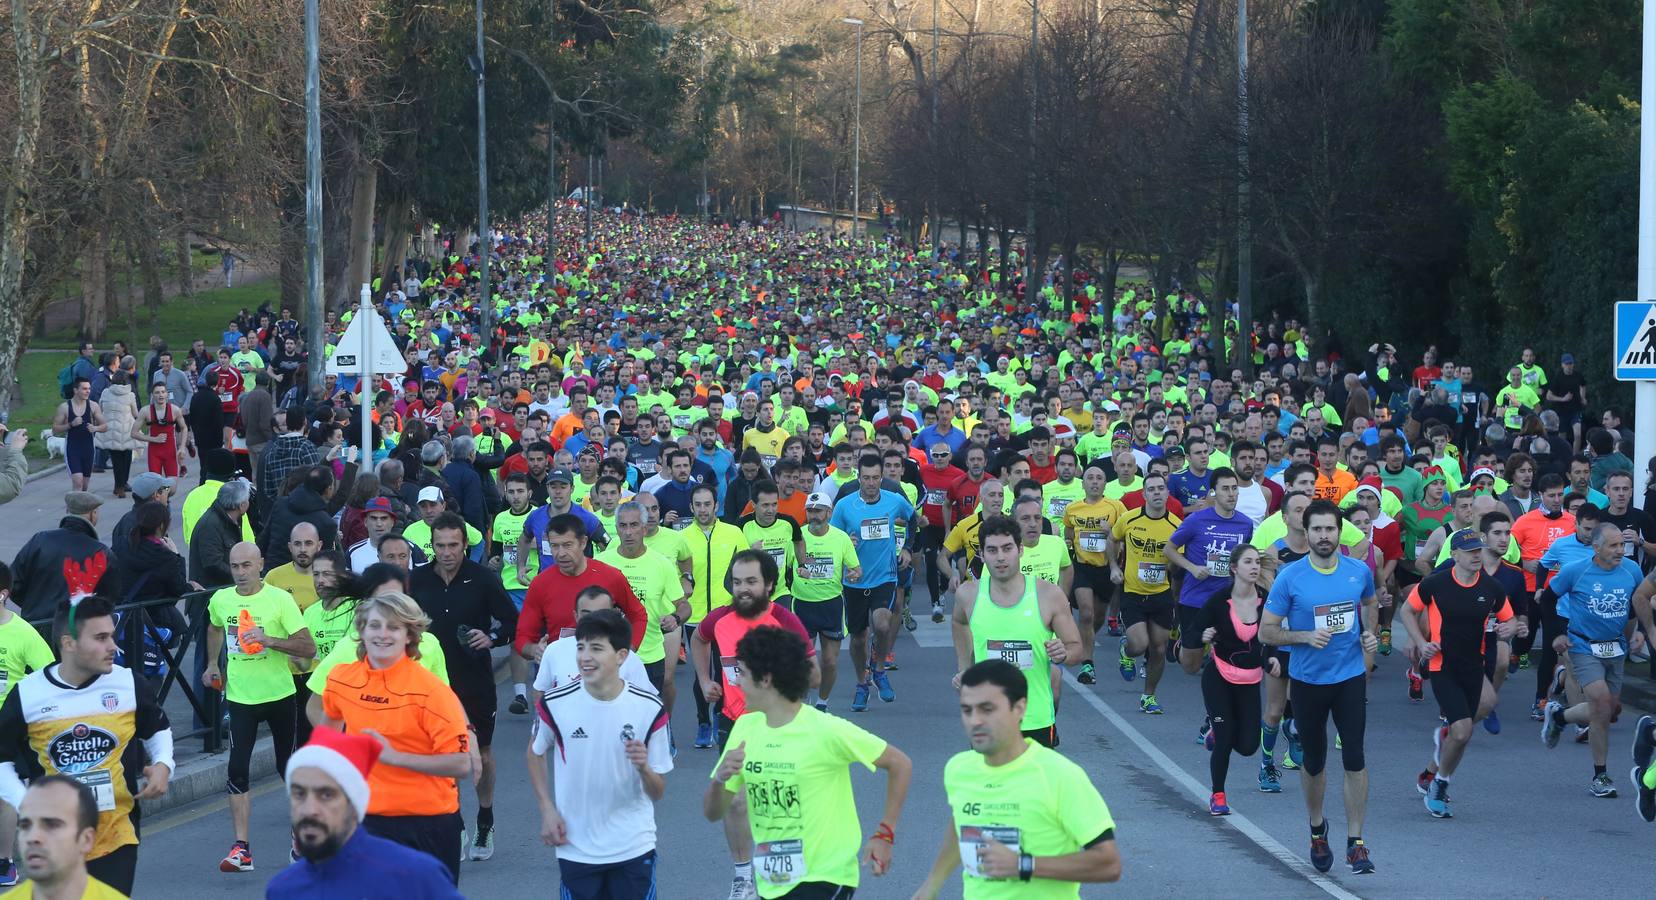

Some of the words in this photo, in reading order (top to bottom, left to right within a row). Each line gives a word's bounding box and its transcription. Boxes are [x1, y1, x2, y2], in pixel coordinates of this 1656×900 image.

[1021, 564, 1033, 572] 46
[227, 616, 238, 625] 46
[1326, 613, 1345, 627] 655
[1000, 650, 1018, 663] 891
[360, 694, 389, 704] LEGEA
[745, 761, 762, 774] 46
[962, 802, 981, 816] 46
[764, 855, 793, 873] 4278
